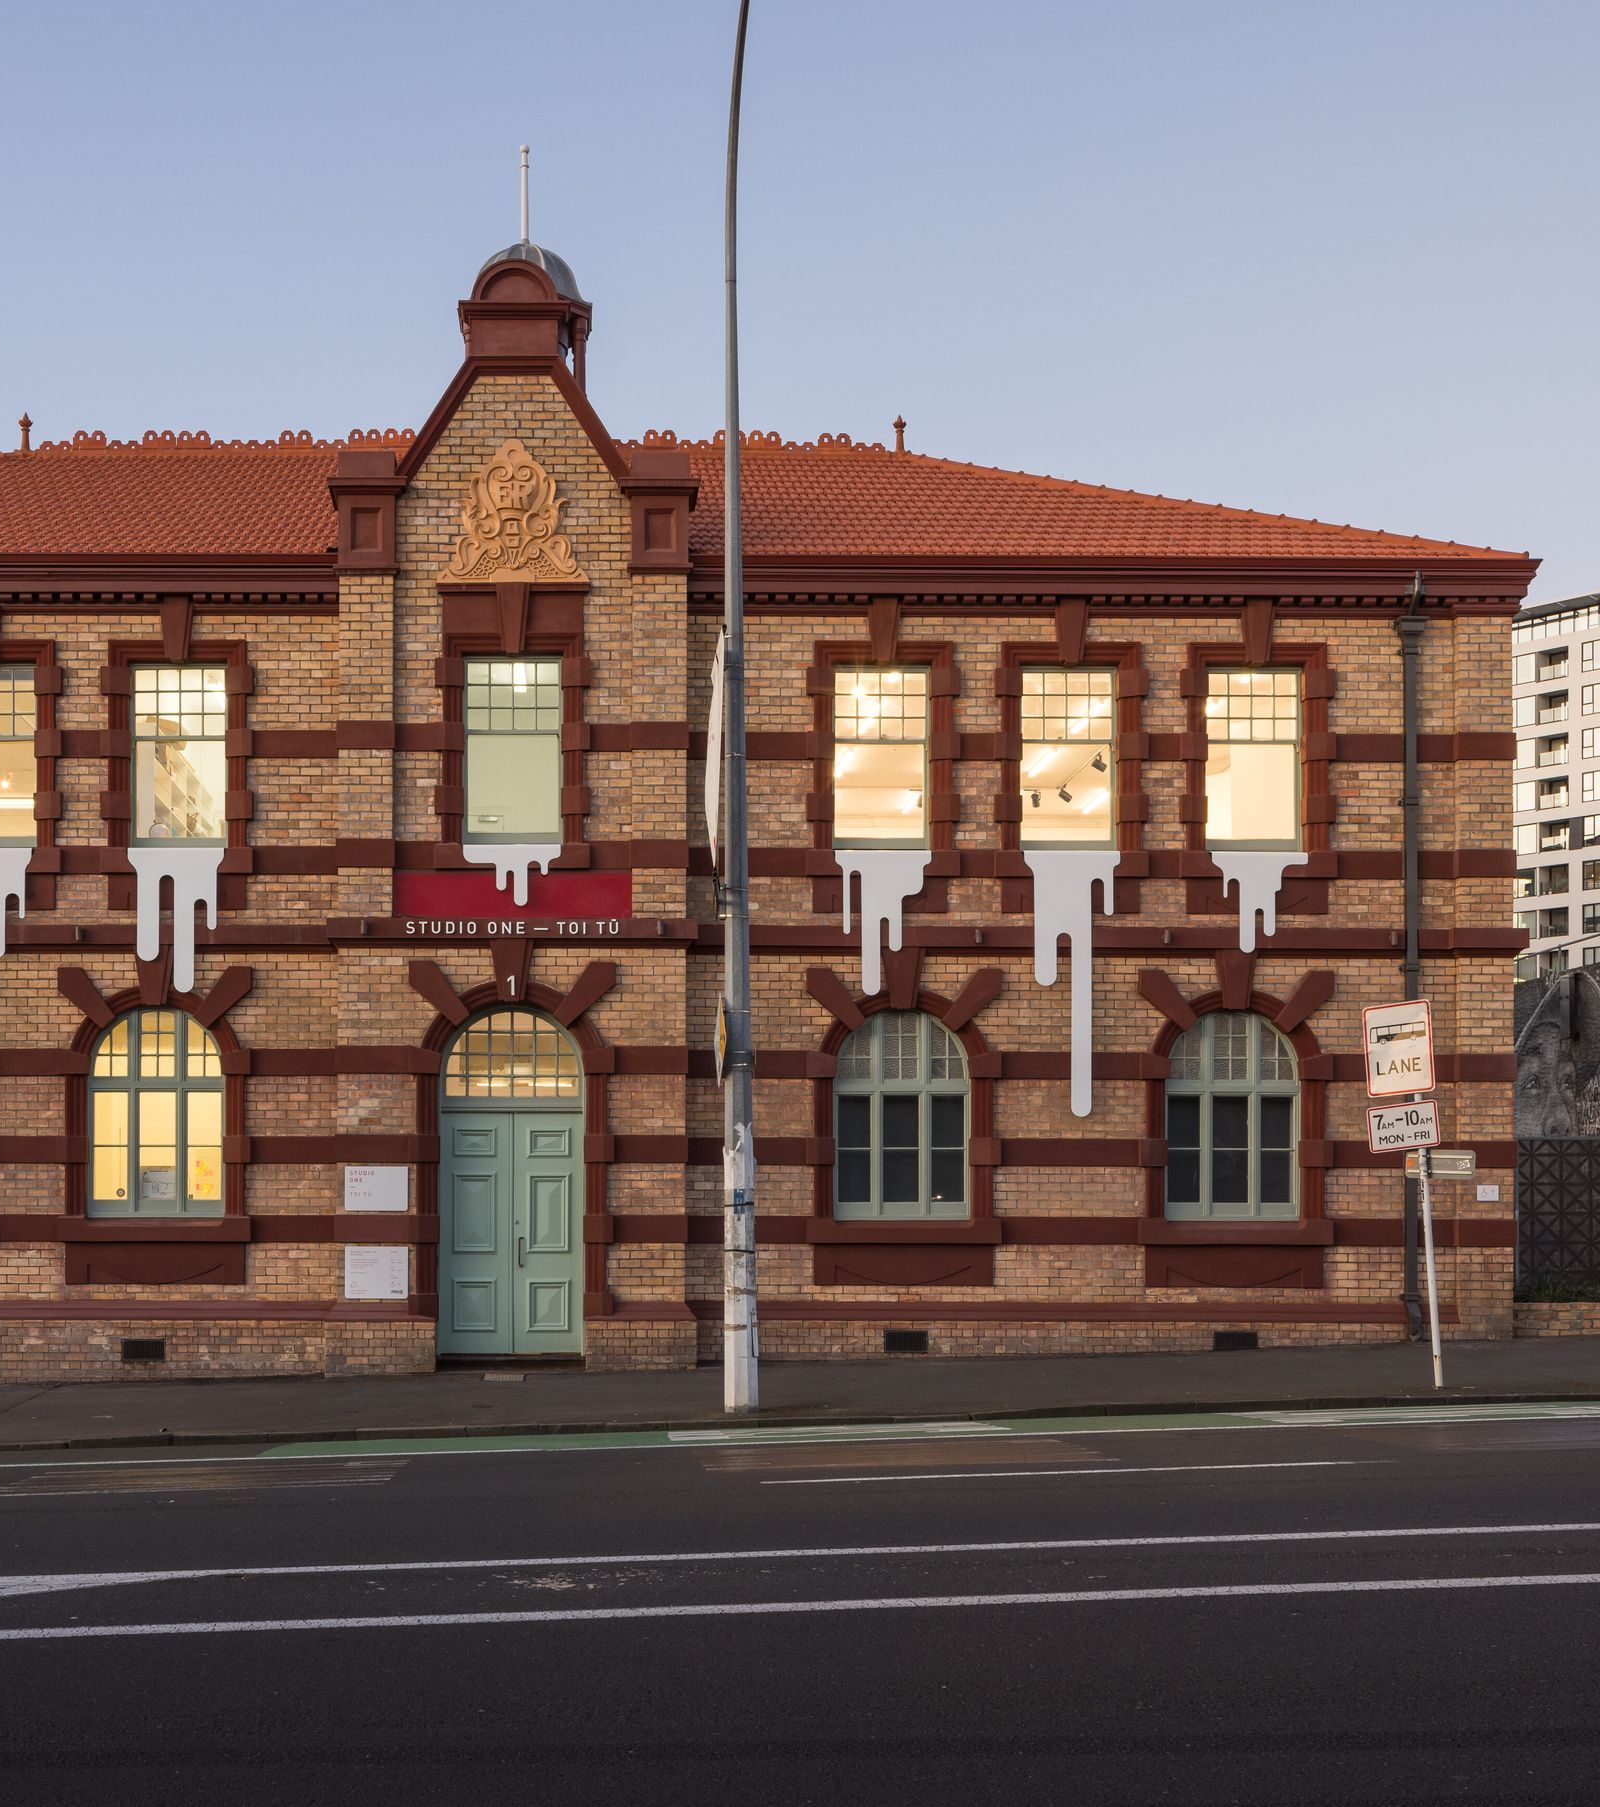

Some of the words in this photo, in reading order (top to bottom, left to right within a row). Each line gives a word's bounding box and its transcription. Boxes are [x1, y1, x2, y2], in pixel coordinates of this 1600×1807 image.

[406, 921, 478, 935] STUDIO
[487, 921, 526, 935] ONE
[557, 921, 587, 935] TOI
[596, 918, 620, 935] TŪ
[506, 975, 517, 996] 1
[1376, 1057, 1422, 1076] LANE
